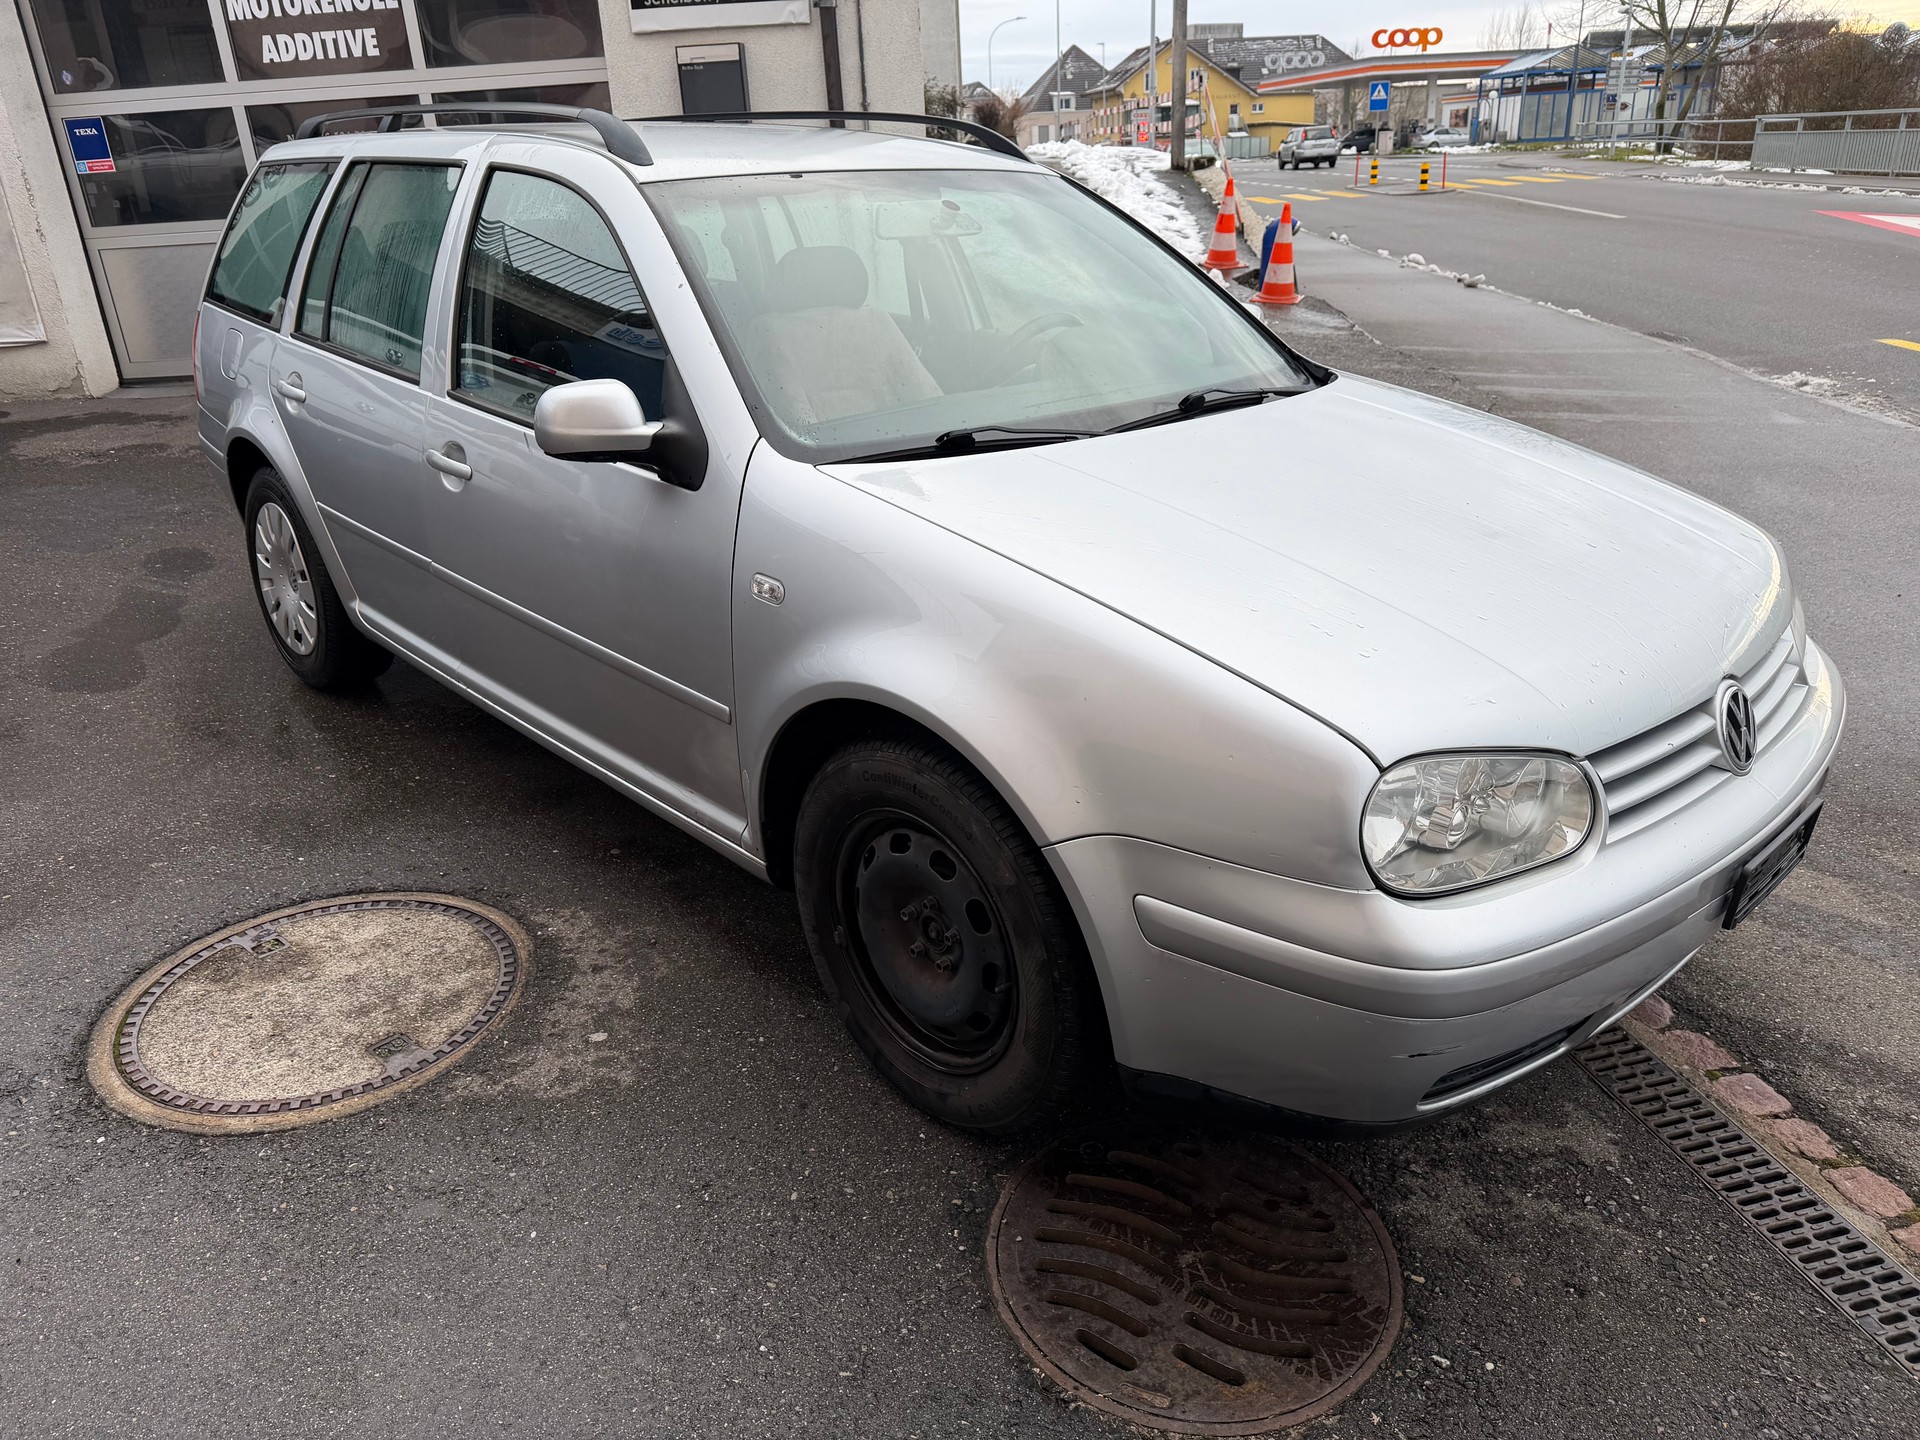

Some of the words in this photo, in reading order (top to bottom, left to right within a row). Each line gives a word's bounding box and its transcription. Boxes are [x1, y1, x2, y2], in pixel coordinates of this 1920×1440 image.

[262, 28, 380, 63] ADDITIVE
[1371, 27, 1443, 52] coop
[74, 128, 99, 136] TEXA
